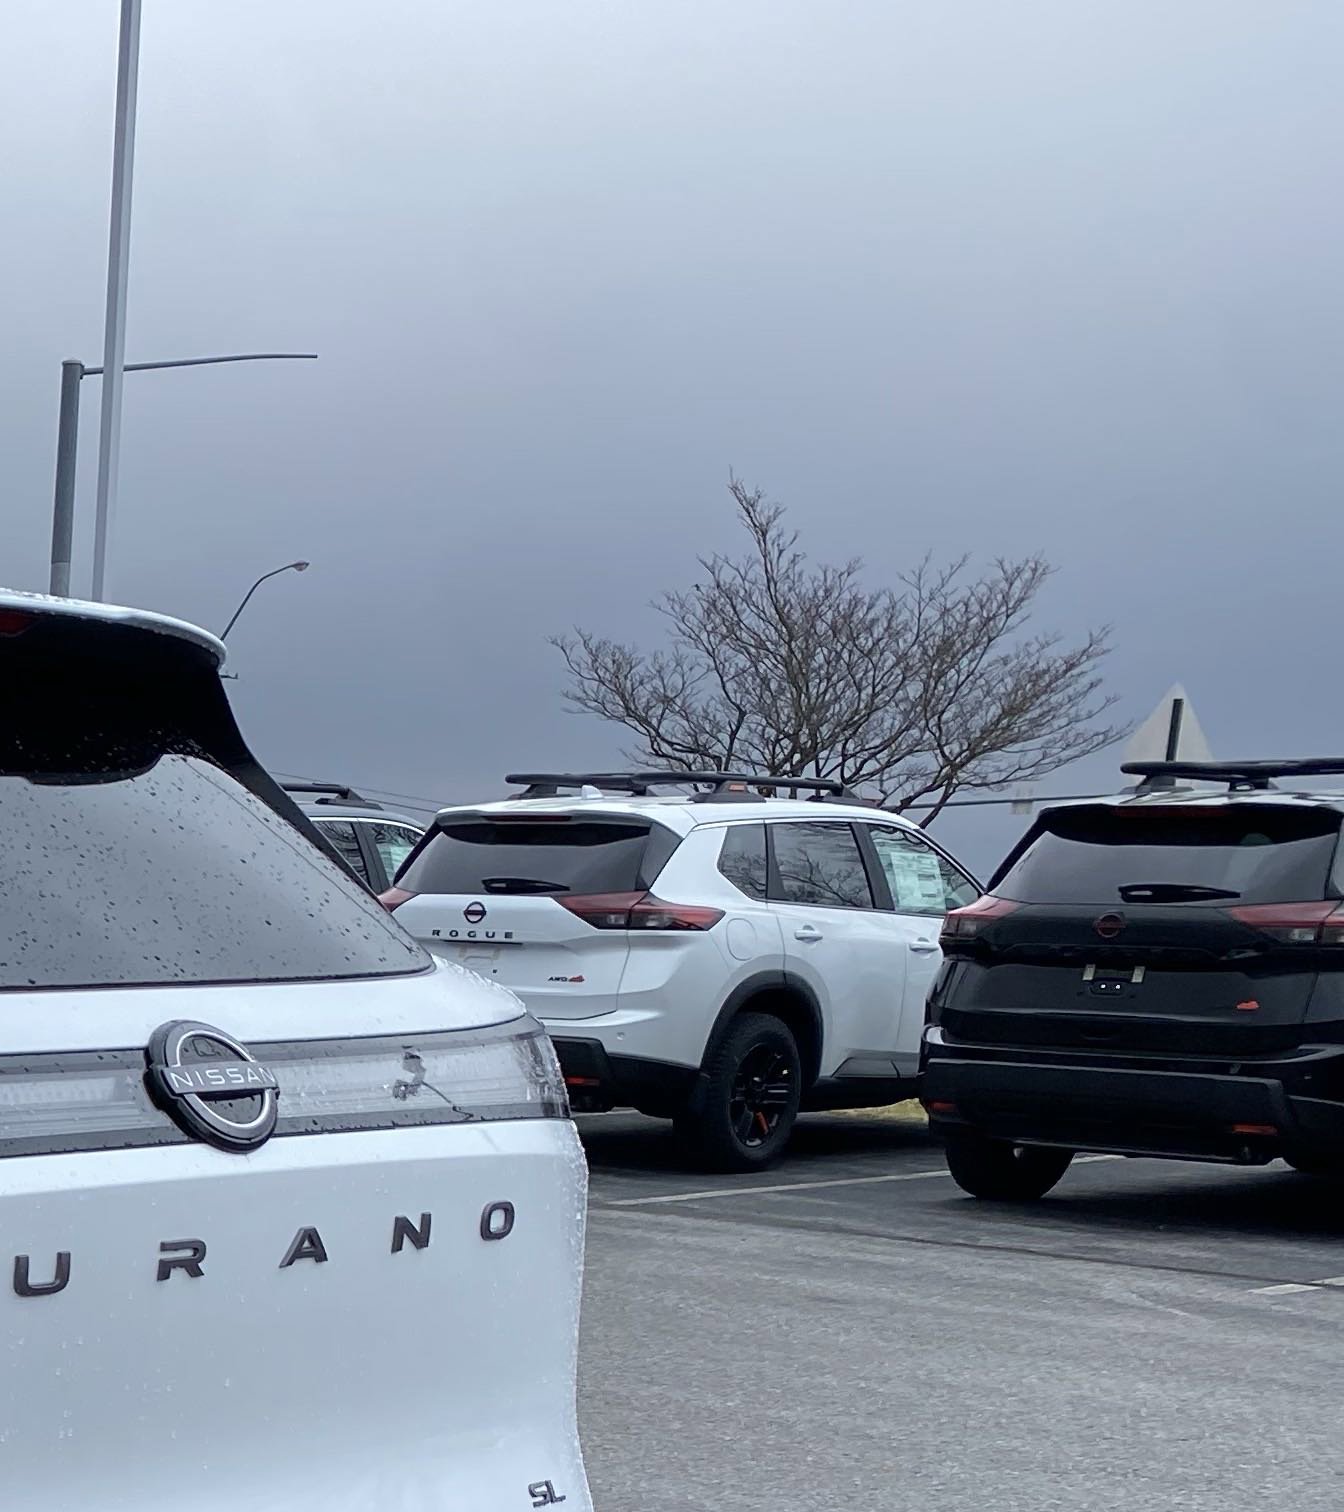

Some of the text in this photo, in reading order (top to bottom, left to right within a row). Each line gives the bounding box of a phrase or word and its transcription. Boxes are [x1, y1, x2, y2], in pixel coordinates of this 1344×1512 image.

[432, 929, 514, 939] ROGUE
[169, 1066, 277, 1090] NISSAN
[527, 1479, 566, 1508] SL
